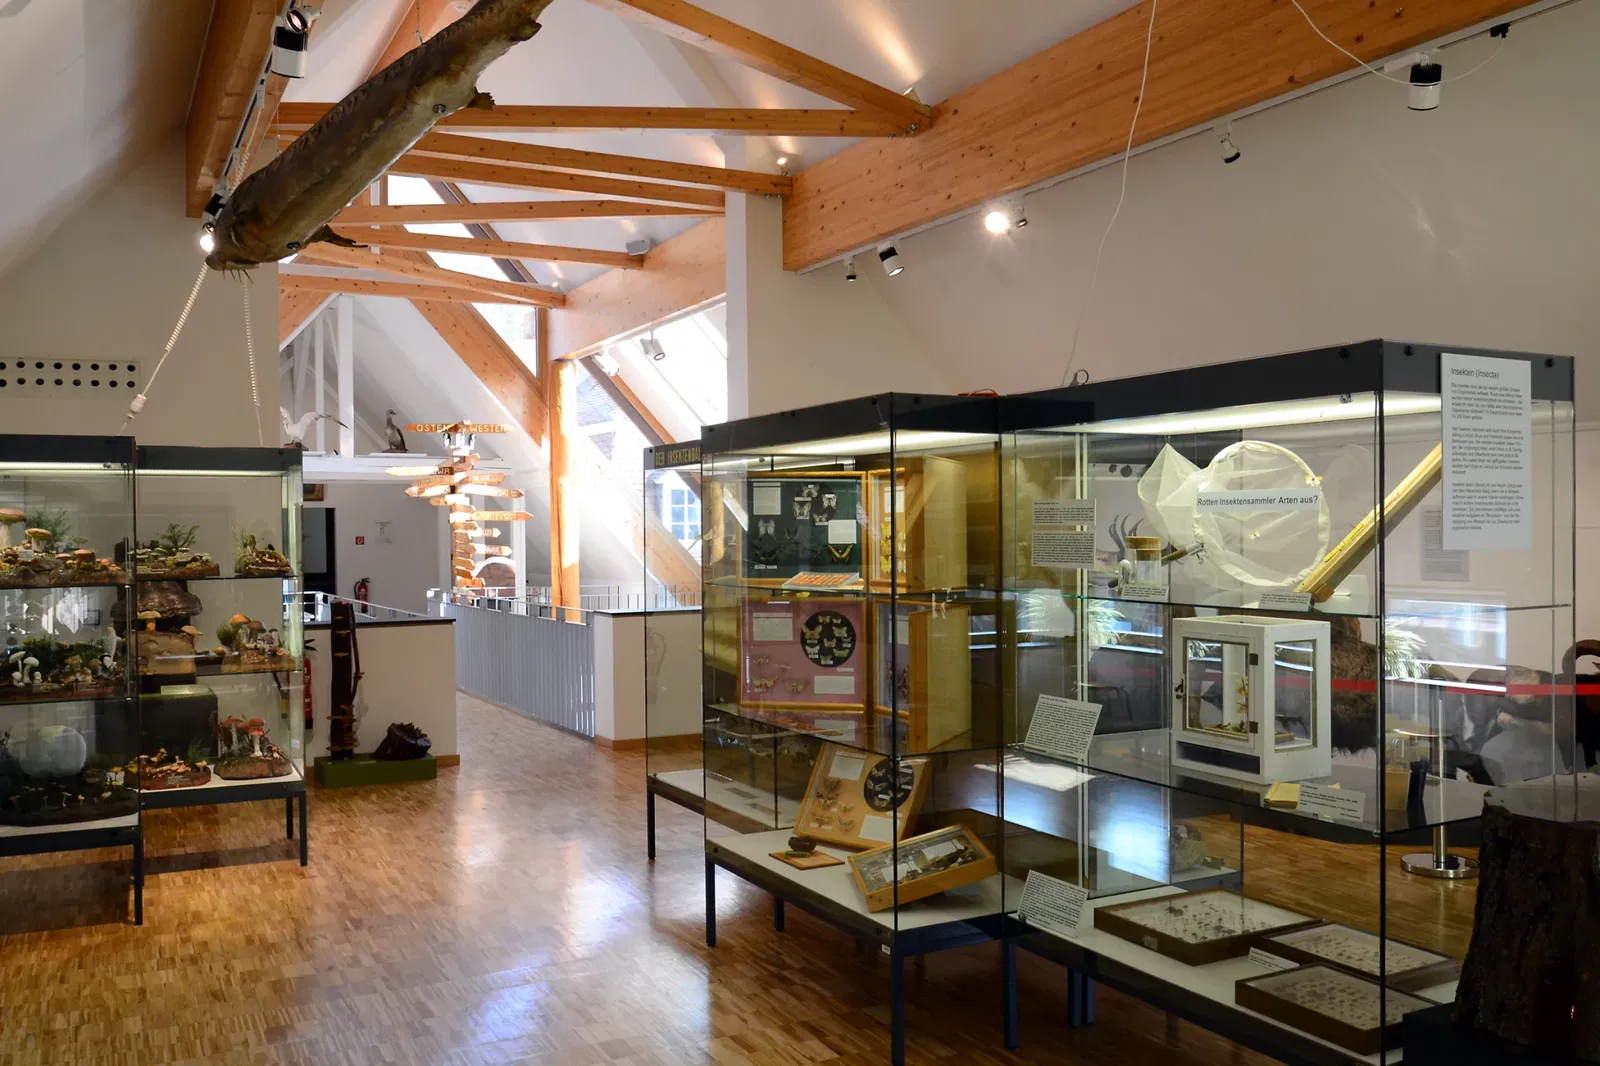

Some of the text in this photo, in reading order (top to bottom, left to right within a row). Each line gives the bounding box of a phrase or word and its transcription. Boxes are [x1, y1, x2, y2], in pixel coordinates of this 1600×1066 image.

[1451, 367, 1500, 380] Insekten (Insecta)
[416, 424, 506, 433] OSTEN WESTEN
[655, 451, 665, 467] DER
[1197, 495, 1319, 506] Rotten Insektensammler Arten aus?
